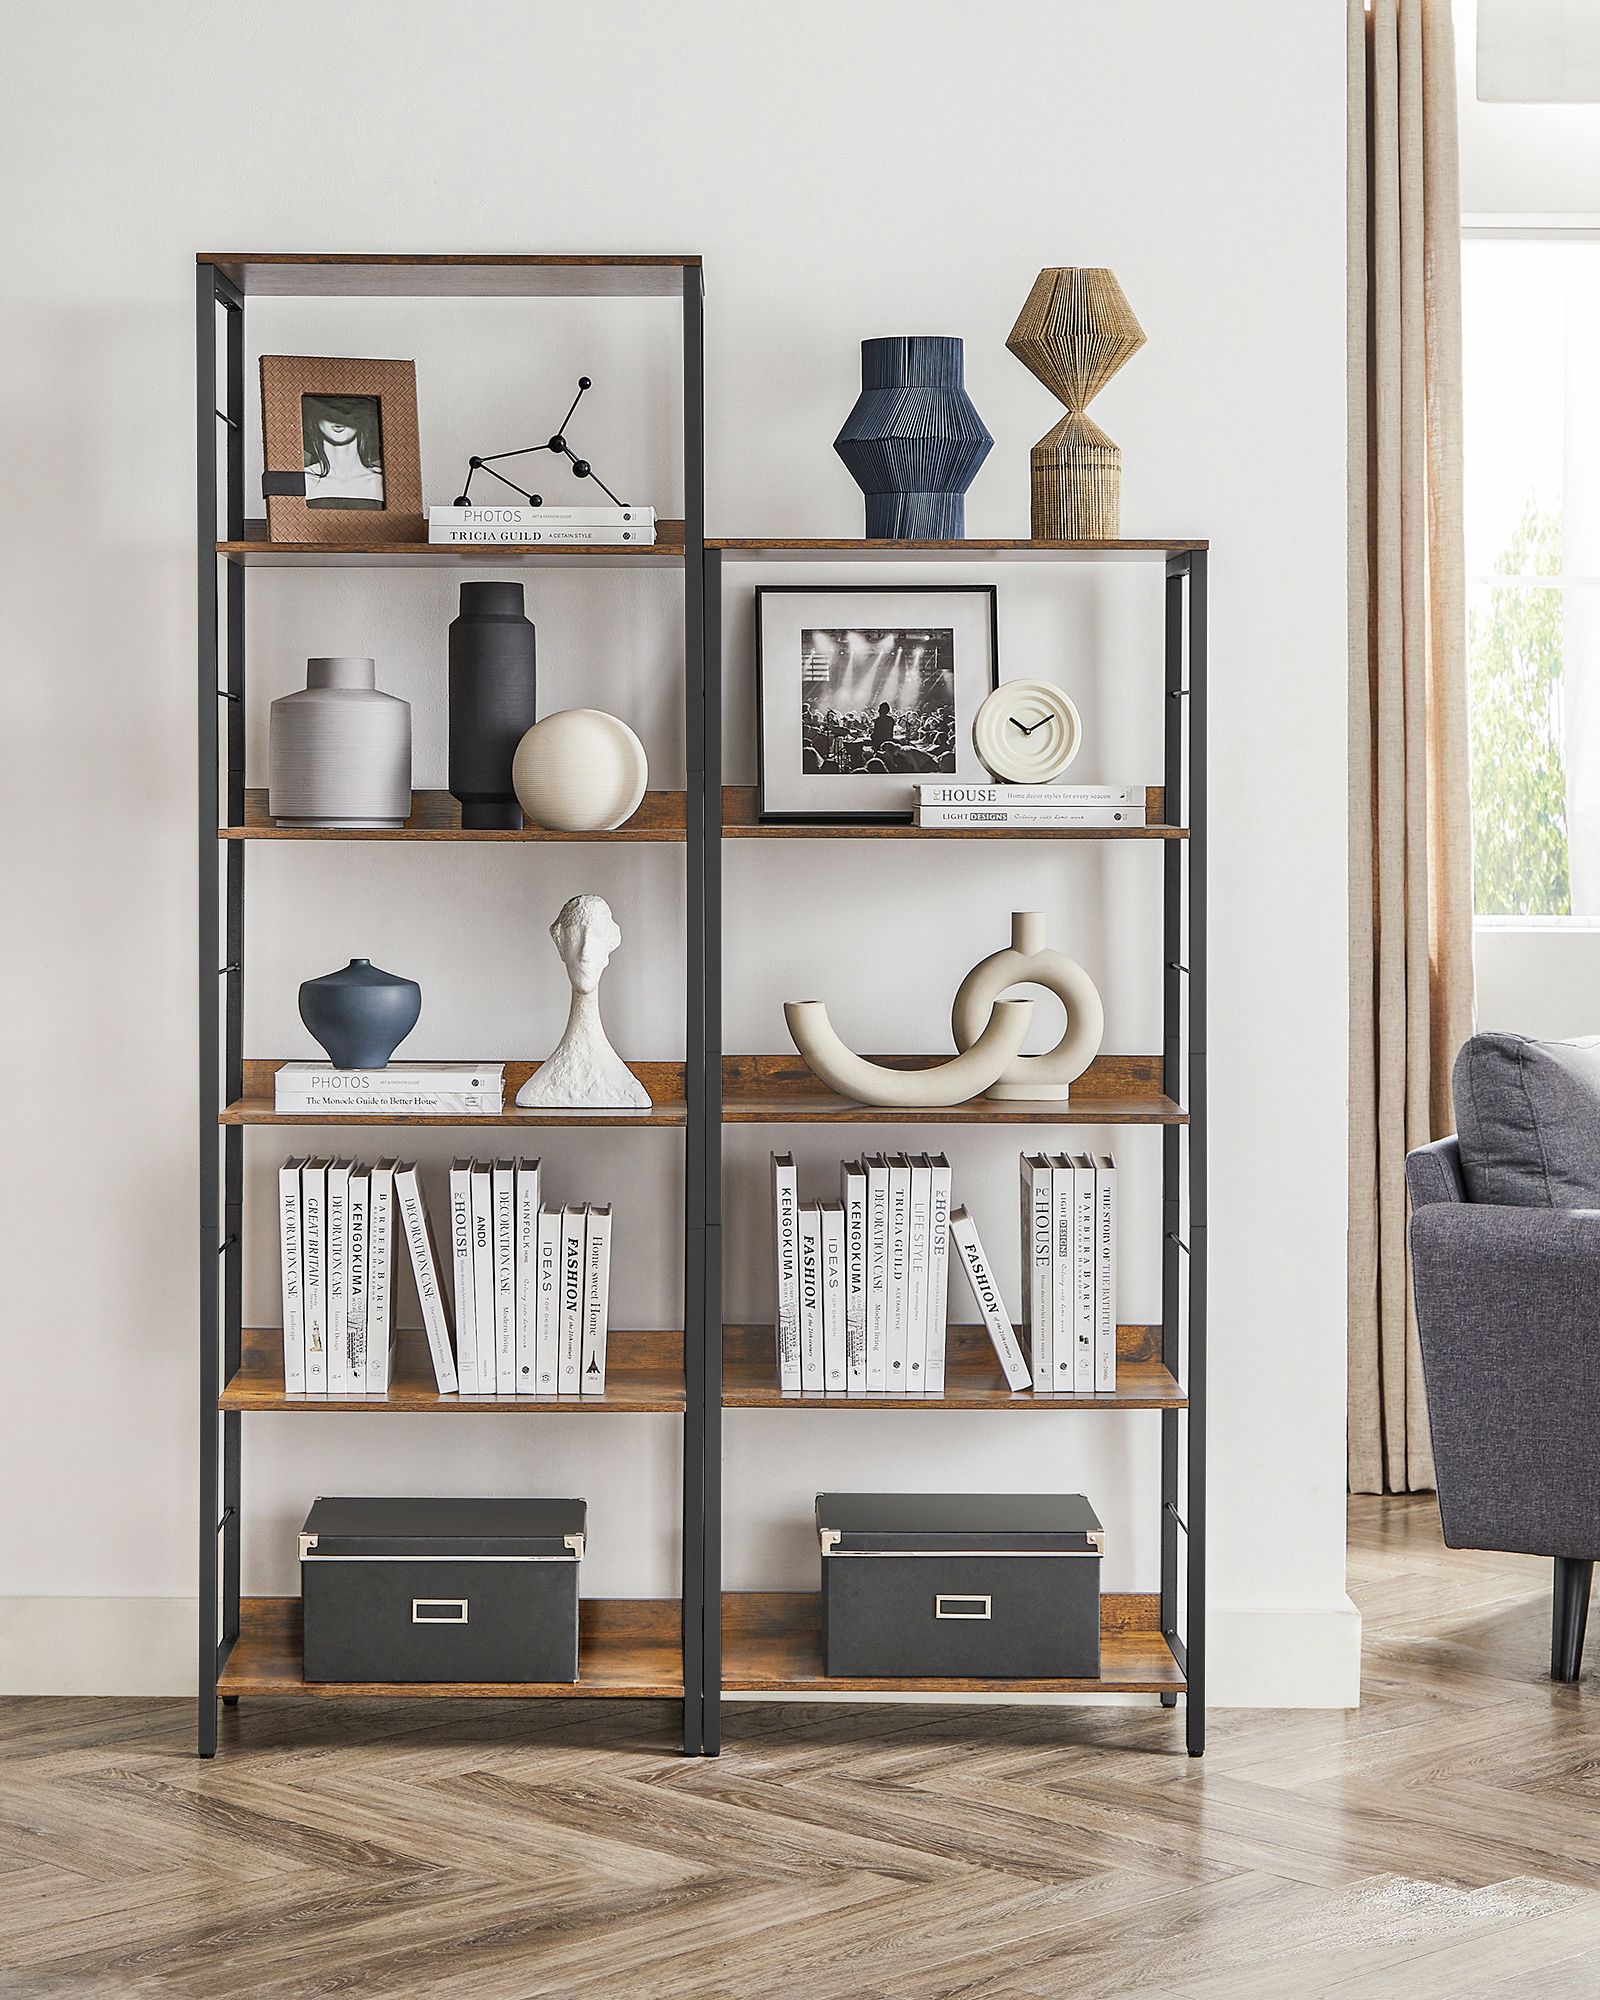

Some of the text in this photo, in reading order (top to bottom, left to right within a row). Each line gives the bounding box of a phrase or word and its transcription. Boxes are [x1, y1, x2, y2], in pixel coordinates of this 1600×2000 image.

[450, 532, 496, 540] TRICIA
[500, 532, 541, 540] GUILD
[464, 510, 522, 522] PHOTOS
[942, 789, 997, 802] HOUSE
[306, 1096, 320, 1105] The
[322, 1096, 355, 1105] Monocle
[356, 1096, 380, 1105] Guide
[390, 1096, 412, 1105] Better
[415, 1096, 438, 1105] House
[312, 1076, 370, 1088] PHOTOS
[894, 1189, 904, 1235] TRICIA
[1036, 1188, 1049, 1196] PC
[1103, 1187, 1111, 1210] THE
[285, 1194, 297, 1270] DECORATION
[308, 1198, 319, 1238] GREAT
[332, 1196, 342, 1269] DECORATION
[455, 1200, 467, 1257] HOUSE
[476, 1216, 486, 1248] ANDO
[499, 1192, 510, 1265] DECORATION
[782, 1188, 793, 1281] KENGOKUMA
[874, 1189, 885, 1263] DECORATION
[913, 1203, 925, 1230] LIFE
[934, 1199, 946, 1256] HOUSE
[1035, 1202, 1050, 1267] HOUSE
[1103, 1212, 1111, 1245] STORY
[308, 1240, 319, 1286] BRITAIN
[352, 1203, 362, 1295] KENGOKUMA
[377, 1194, 387, 1323] BARBERA BAREY
[405, 1198, 428, 1271] DECORATION
[421, 1272, 435, 1301] CASE
[542, 1241, 552, 1292] IDEAS
[828, 1238, 838, 1288] IDEAS
[851, 1201, 861, 1294] KENGOKUMA
[894, 1240, 904, 1280] GUILD
[913, 1234, 924, 1272] STYLE
[1083, 1193, 1091, 1321] BARBERA BAREY
[1103, 1248, 1110, 1261] OF
[287, 1271, 298, 1299] CASE
[332, 1272, 342, 1300] CASE
[500, 1268, 510, 1296] CASE
[566, 1237, 578, 1312] FASHION
[589, 1236, 603, 1336] Home sweet Home
[803, 1235, 816, 1309] FASHION
[873, 1265, 884, 1292] CASE
[964, 1244, 1000, 1313] FASHION
[1102, 1264, 1110, 1285] THE
[1102, 1288, 1110, 1336] BATHTUB
